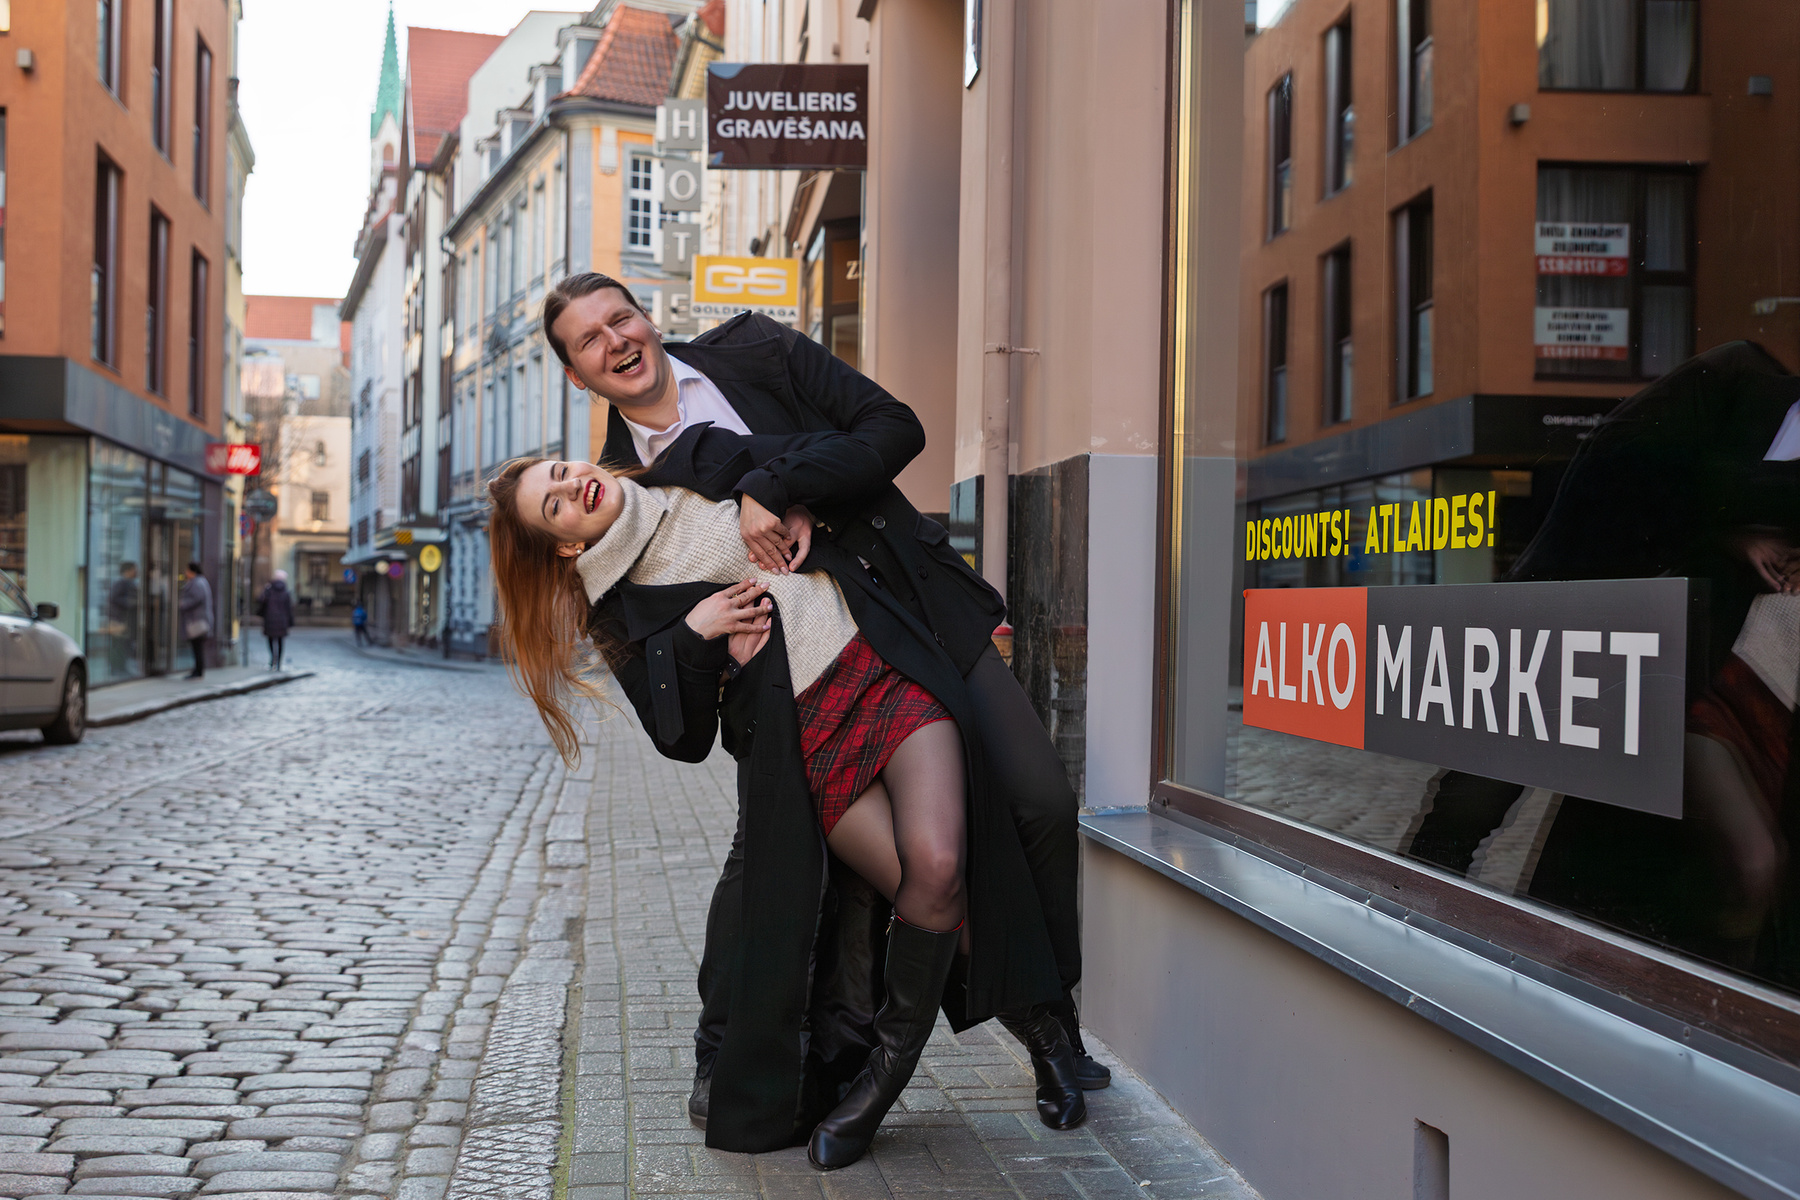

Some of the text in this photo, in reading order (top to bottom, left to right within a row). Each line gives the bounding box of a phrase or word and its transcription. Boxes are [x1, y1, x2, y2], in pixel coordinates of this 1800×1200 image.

[724, 91, 857, 112] JUVELIERIS
[716, 117, 865, 140] GRAVĒŠANA
[668, 107, 698, 325] HOTE
[705, 265, 787, 296] GS
[693, 305, 749, 314] GOLDE
[1246, 490, 1496, 561] DISCOUNTS! ATLAIDES!
[1251, 621, 1660, 756] ALKO MARKET
